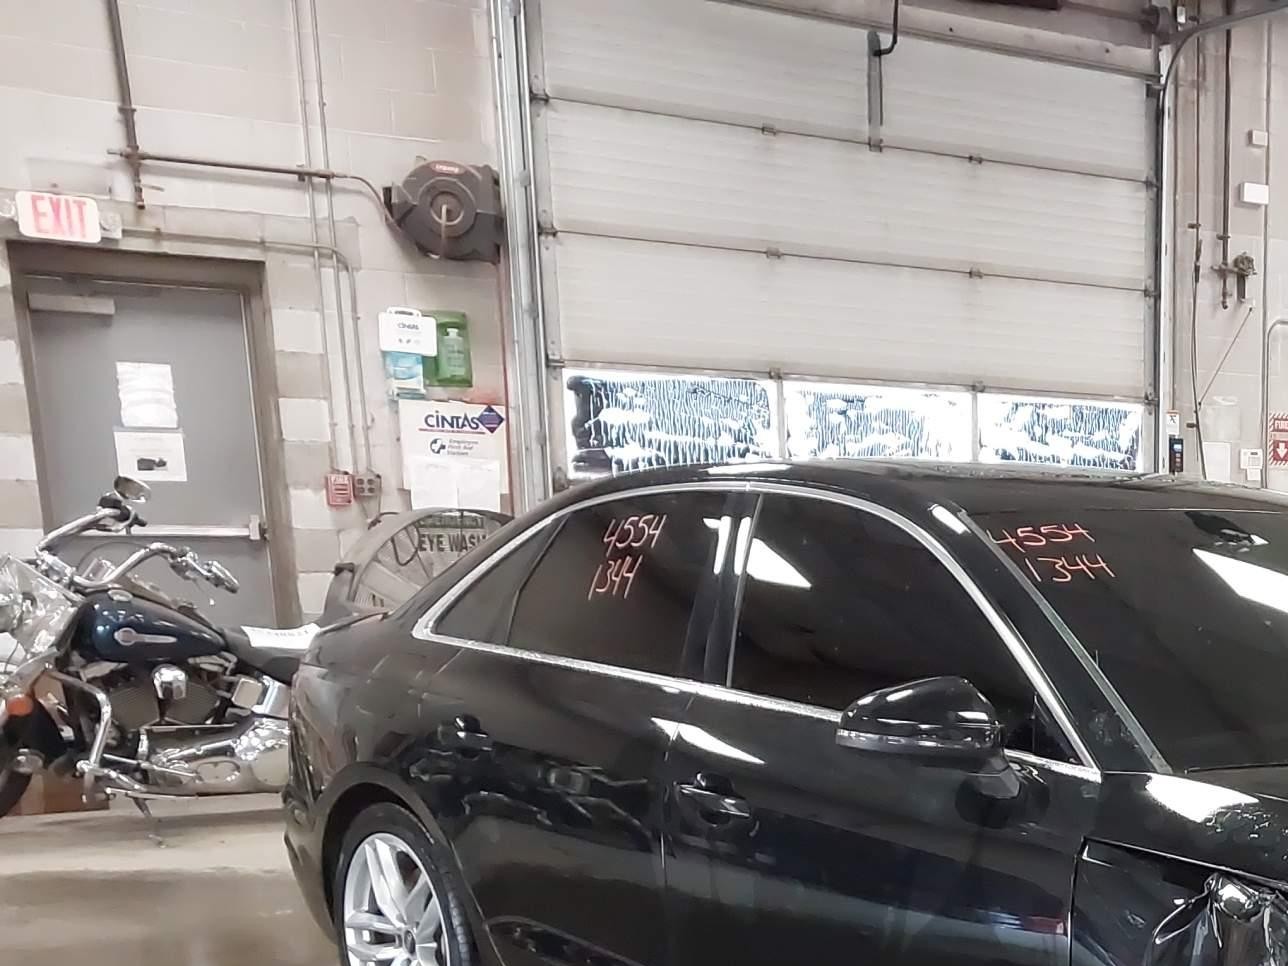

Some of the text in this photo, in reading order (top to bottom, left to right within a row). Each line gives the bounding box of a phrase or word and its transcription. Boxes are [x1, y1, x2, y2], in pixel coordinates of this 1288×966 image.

[31, 195, 86, 238] EXIT
[419, 533, 445, 552] EYE
[604, 514, 667, 557] 4554
[986, 523, 1095, 552] 4554
[588, 555, 643, 600] 1344
[1025, 554, 1115, 582] 1344
